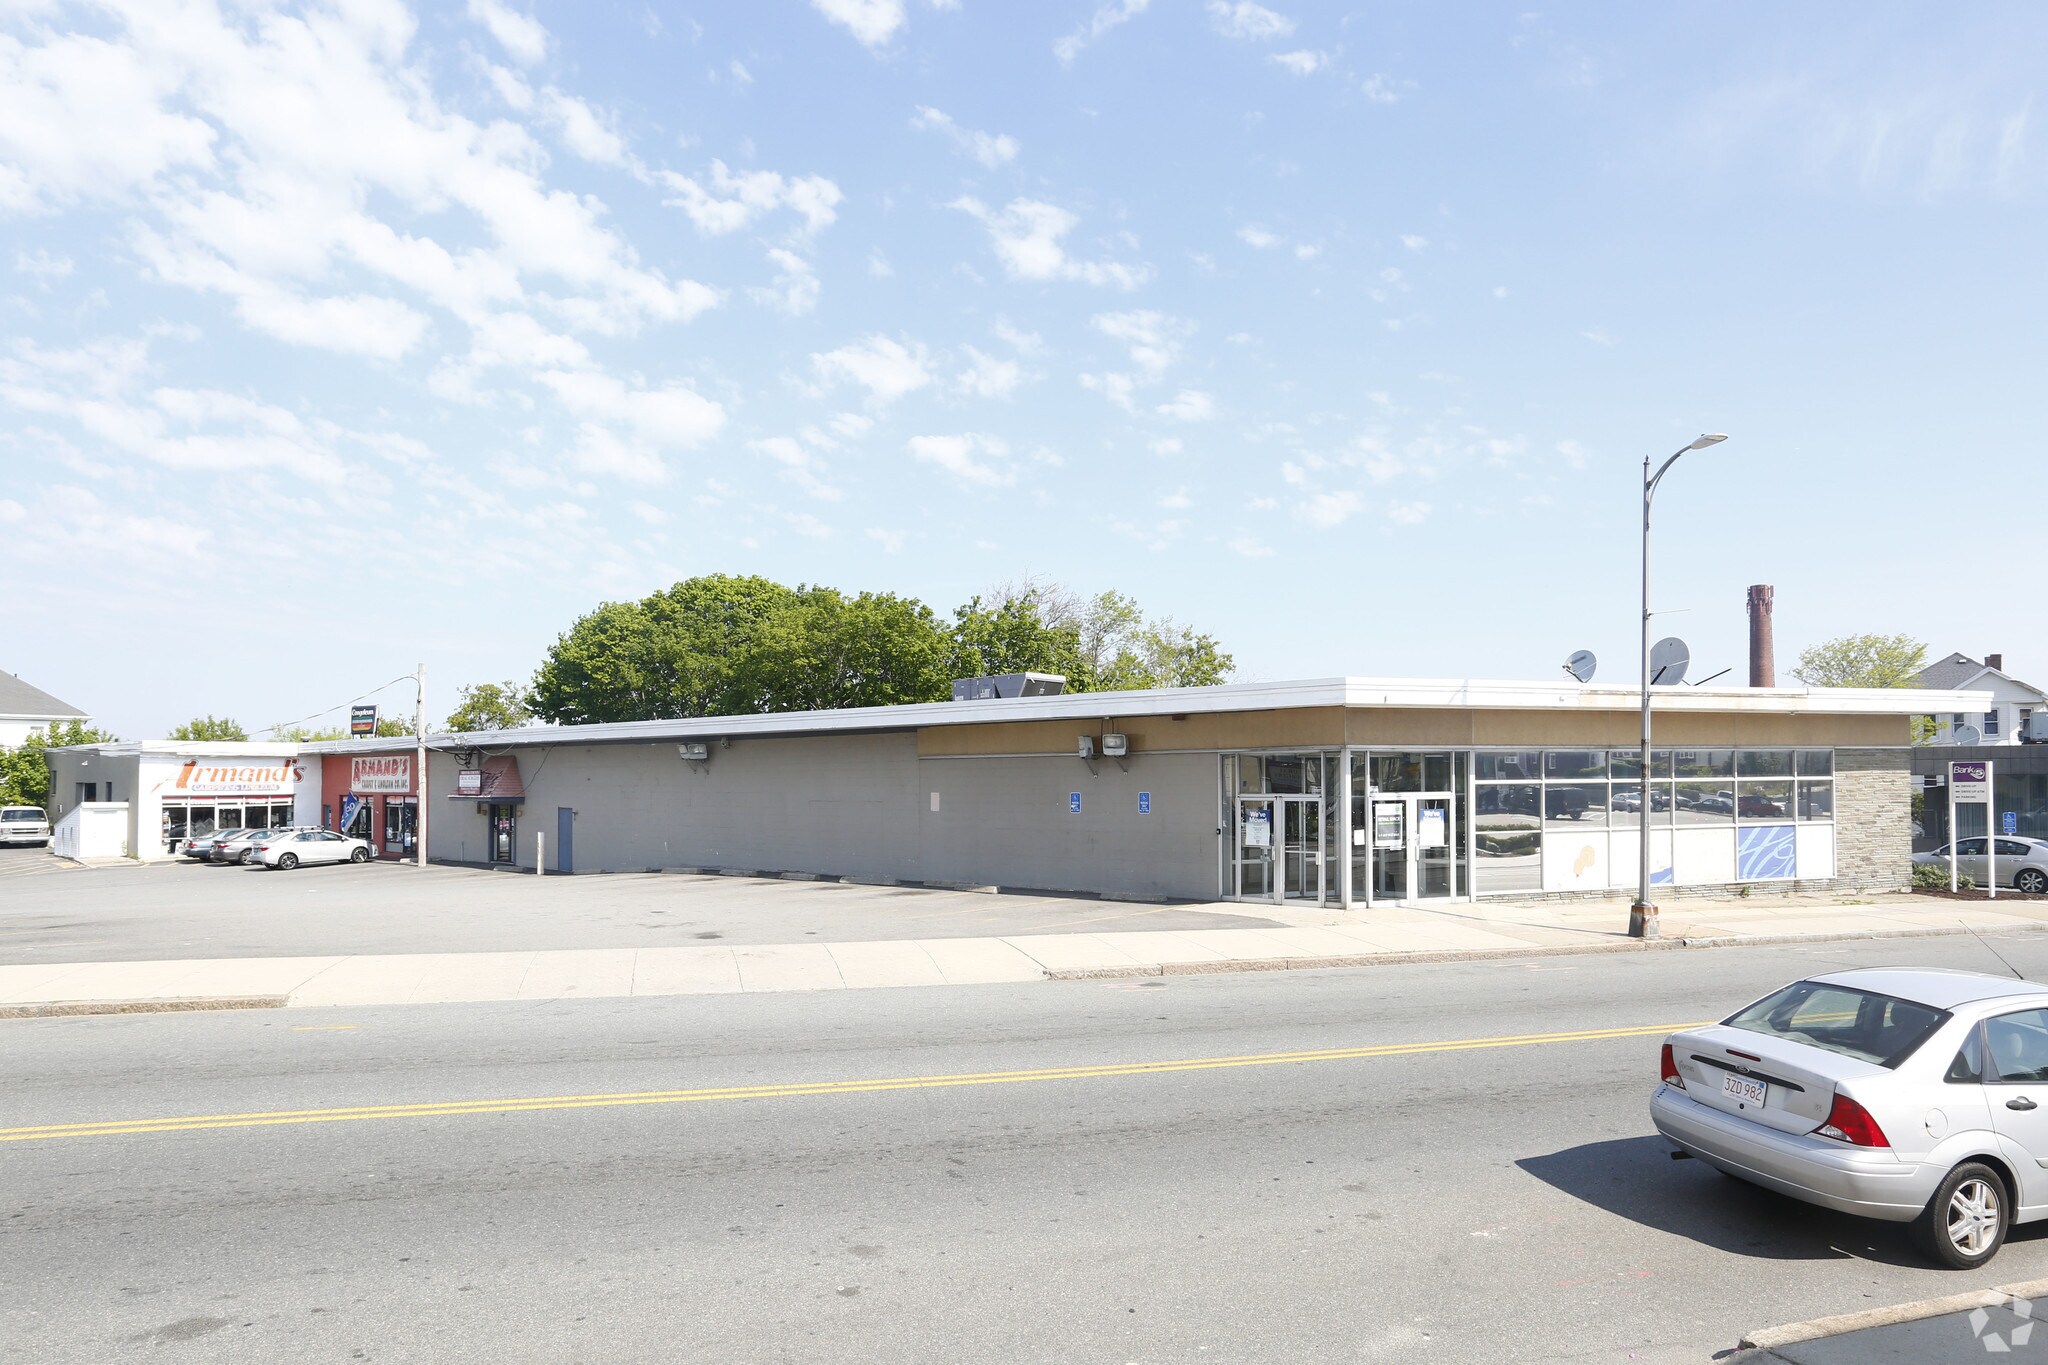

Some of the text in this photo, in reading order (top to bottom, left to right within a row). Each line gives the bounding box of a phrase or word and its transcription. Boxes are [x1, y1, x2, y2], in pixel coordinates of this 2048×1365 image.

[353, 758, 409, 784] ARMAND'S
[1725, 1077, 1743, 1094] 3ZD
[1744, 1083, 1763, 1101] 982
